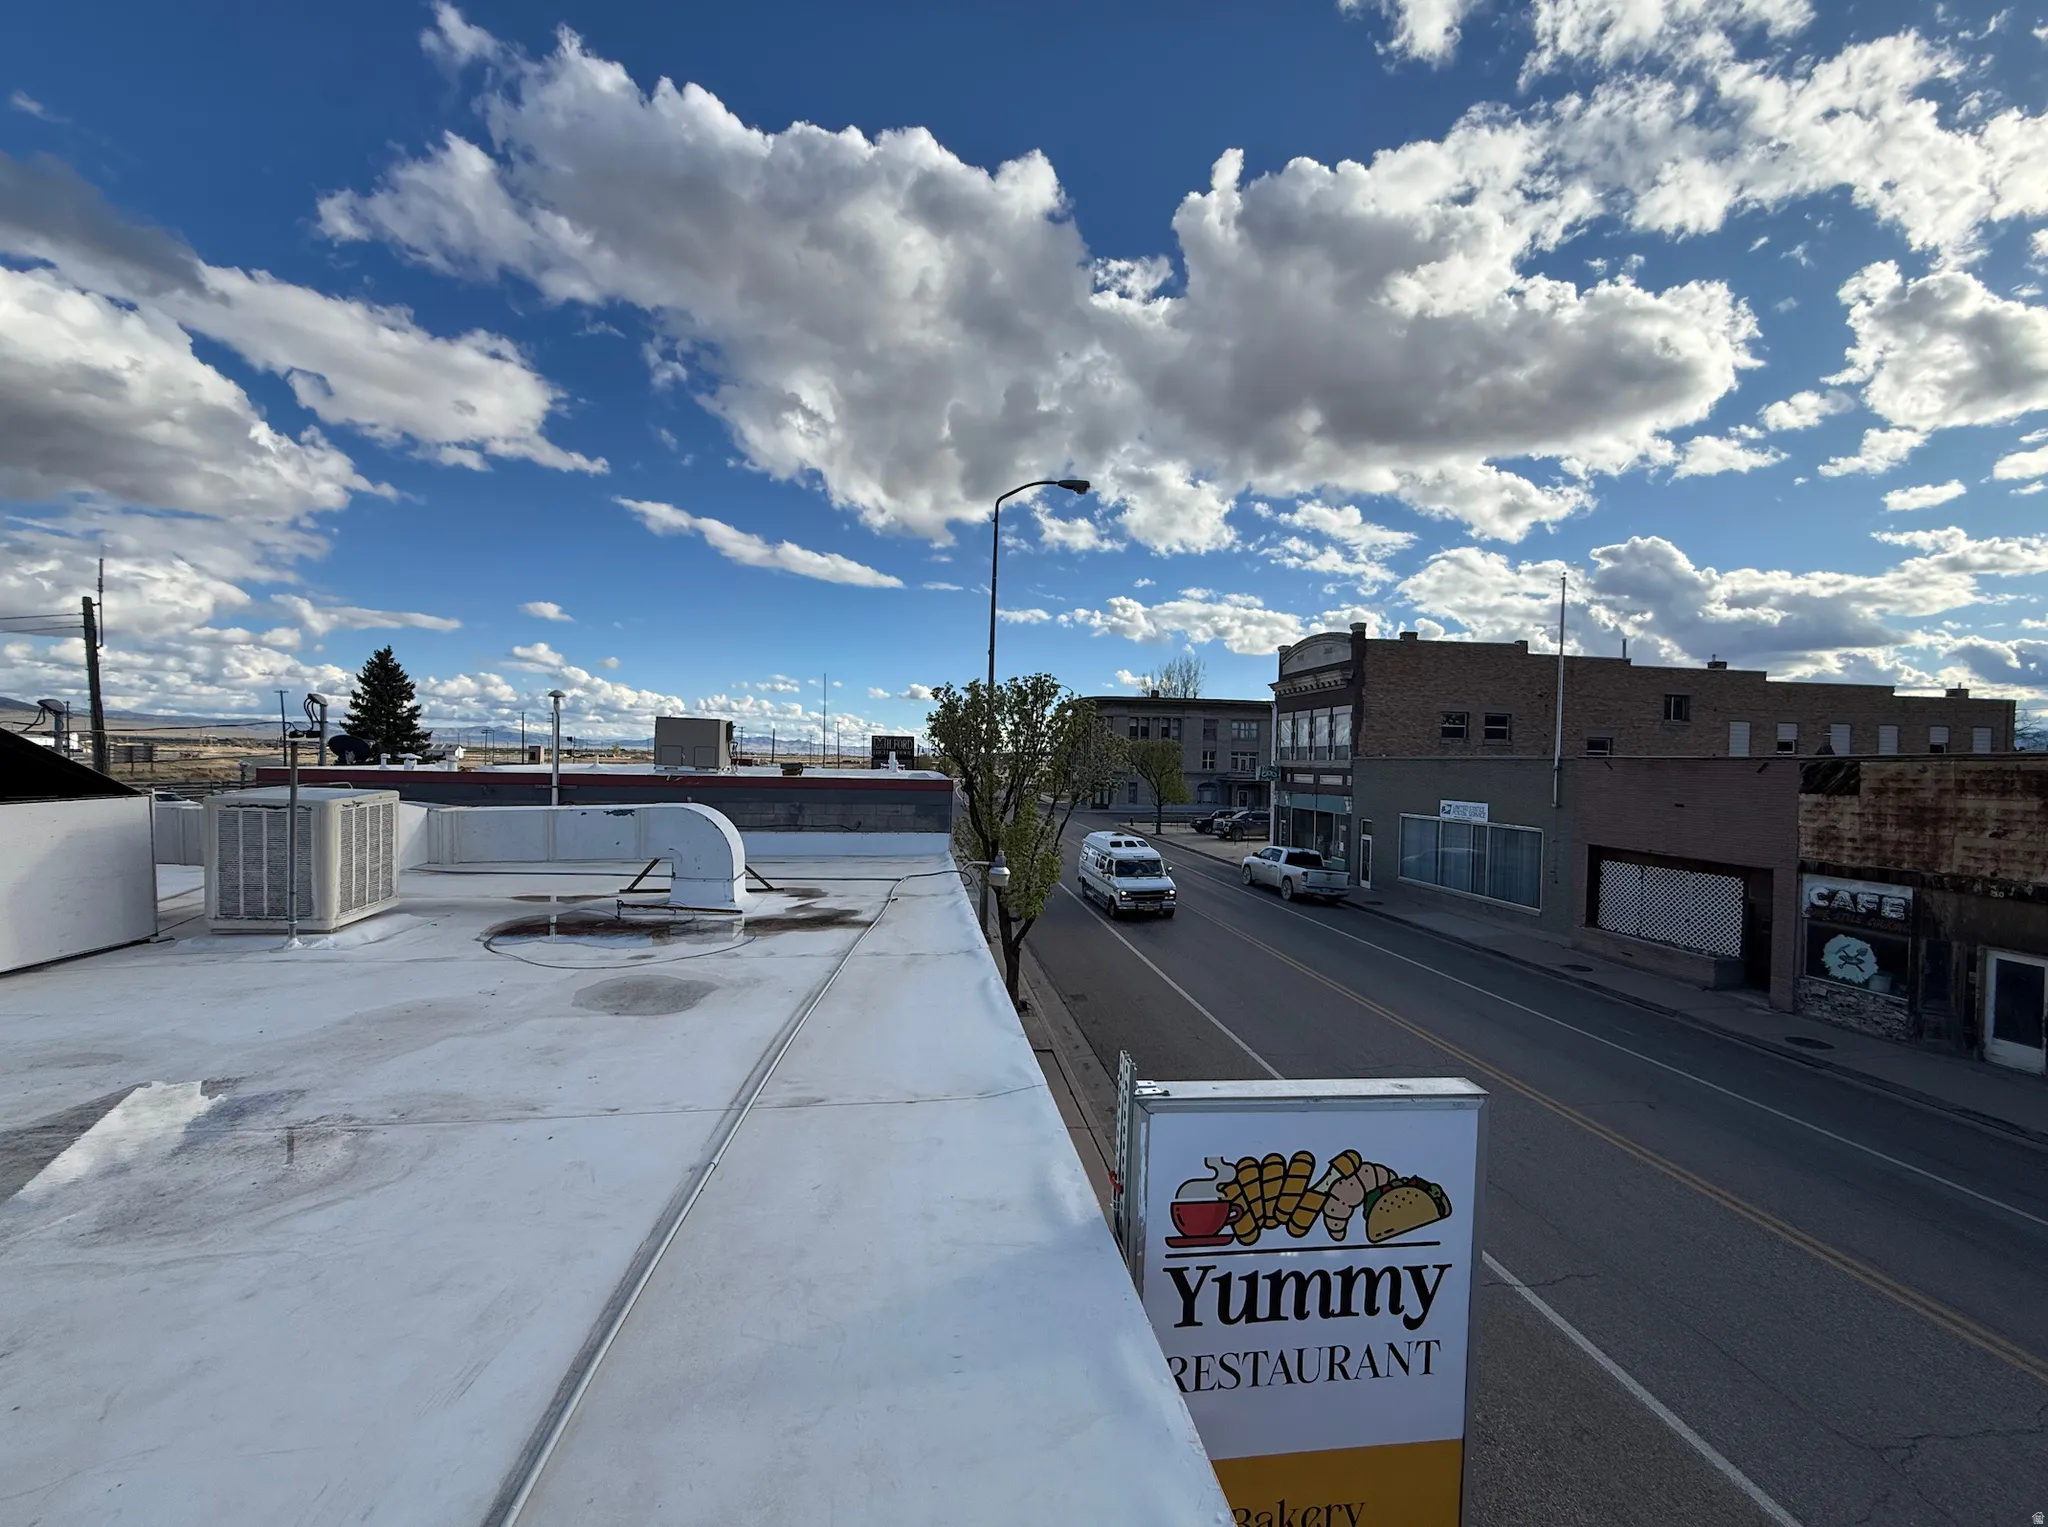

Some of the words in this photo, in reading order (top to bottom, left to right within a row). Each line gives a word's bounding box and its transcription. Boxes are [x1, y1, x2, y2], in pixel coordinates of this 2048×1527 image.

[873, 737, 913, 750] MILFORD
[1808, 886, 1906, 920] CAFE
[1162, 1263, 1453, 1331] Yummy
[1166, 1339, 1442, 1394] RESTAURANT
